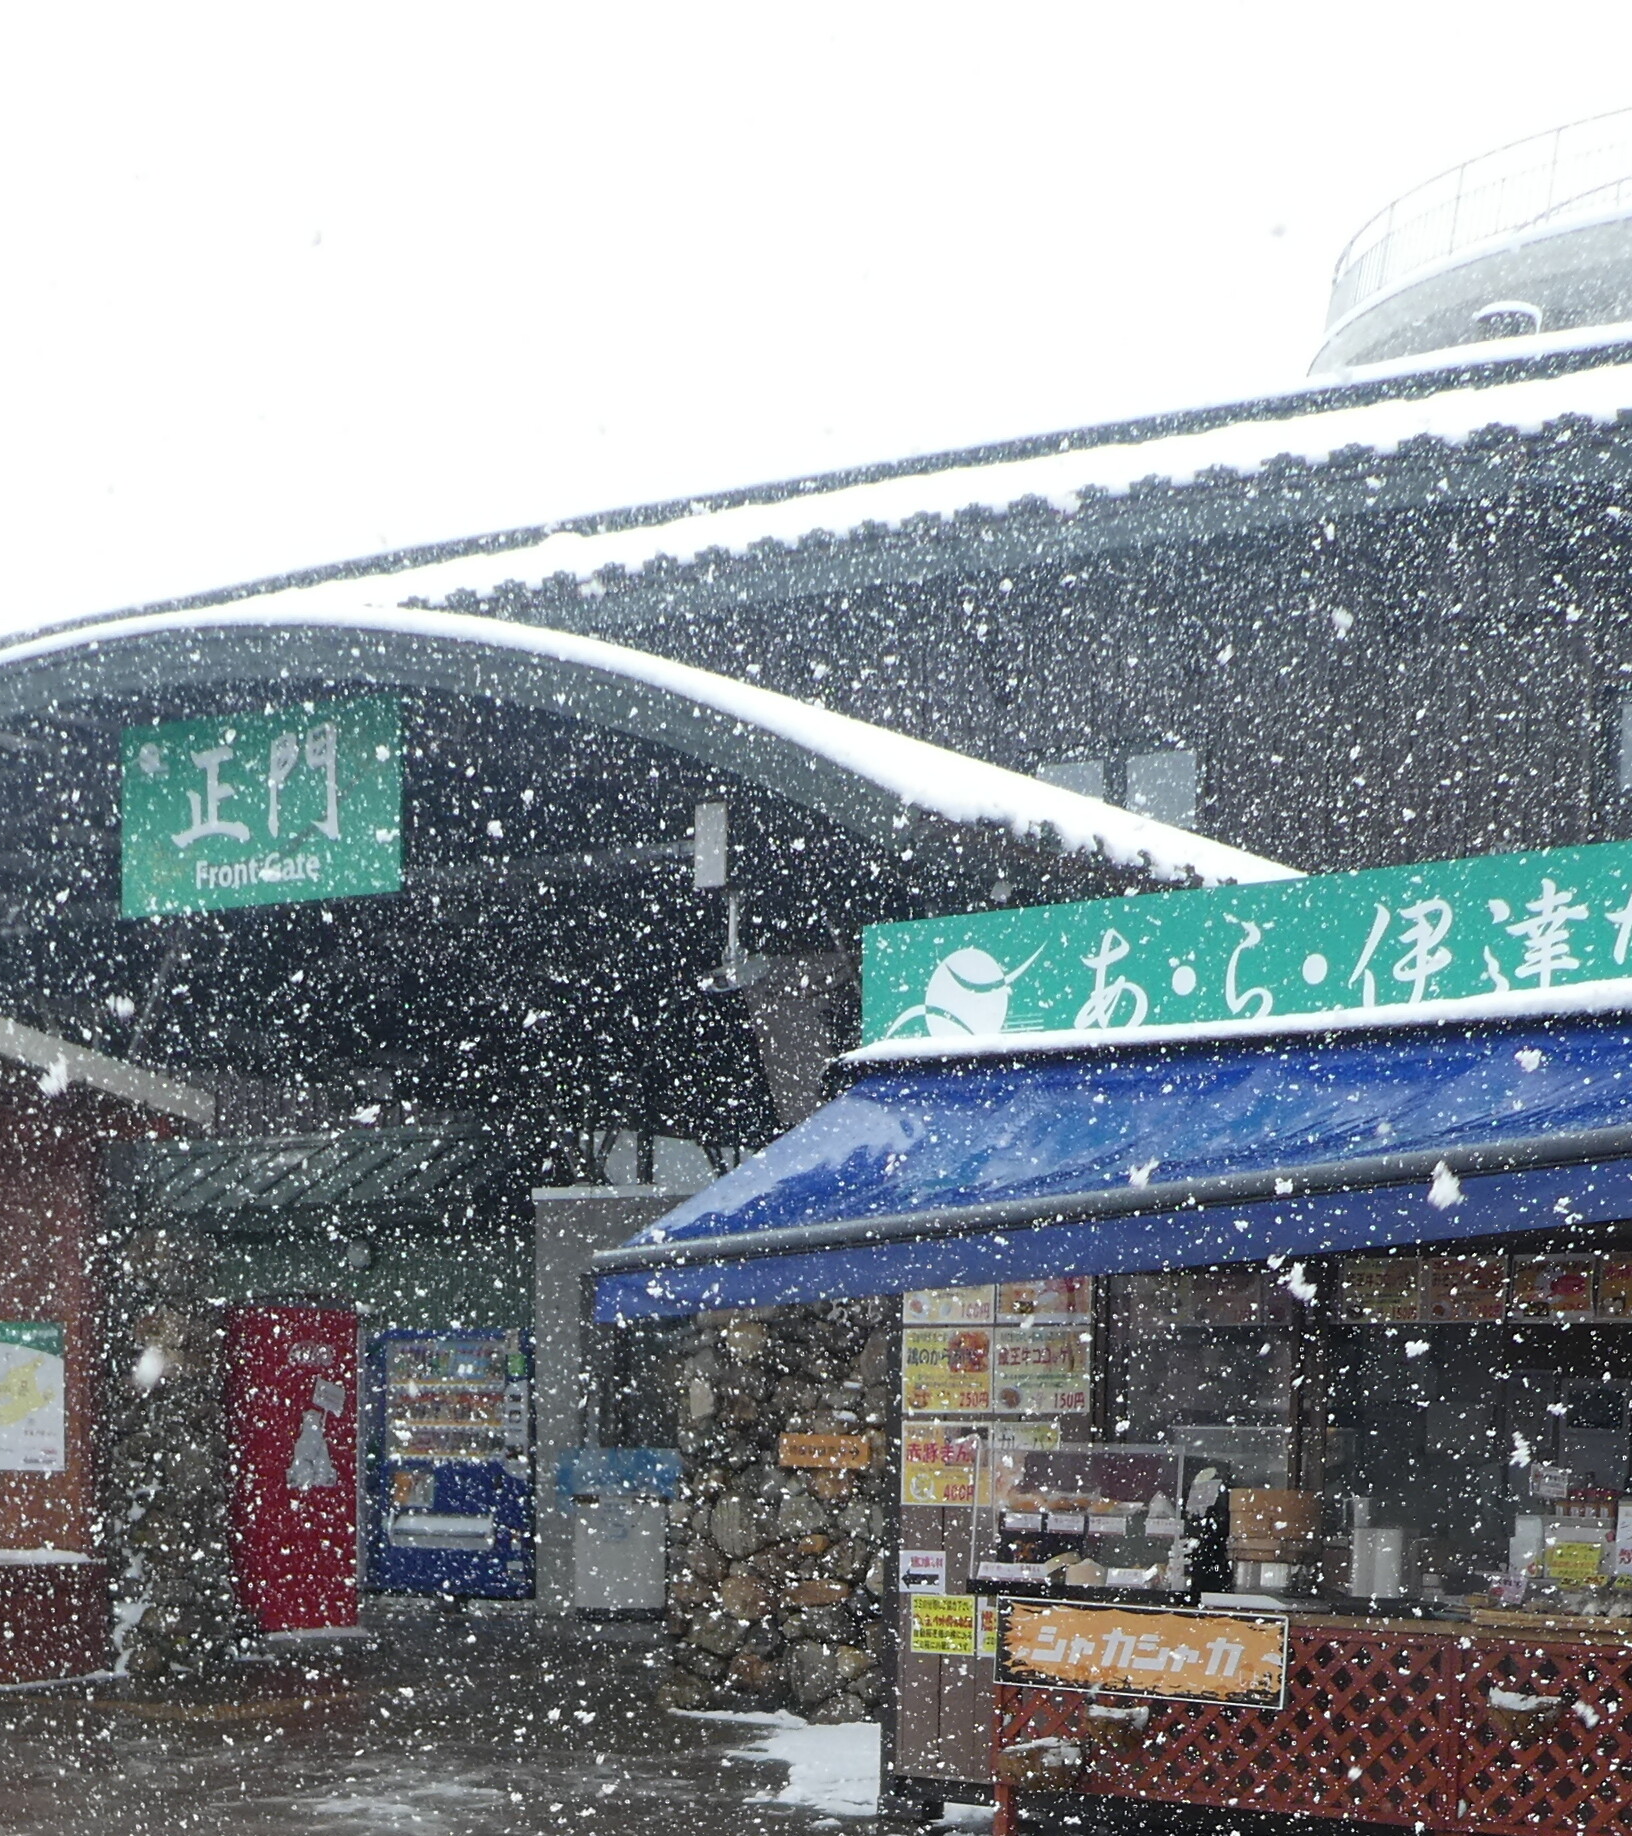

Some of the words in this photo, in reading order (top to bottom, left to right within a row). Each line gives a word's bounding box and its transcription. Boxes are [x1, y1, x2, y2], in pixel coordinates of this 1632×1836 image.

[171, 720, 340, 849] 正門
[196, 859, 259, 890] Front
[260, 852, 321, 883] Gate
